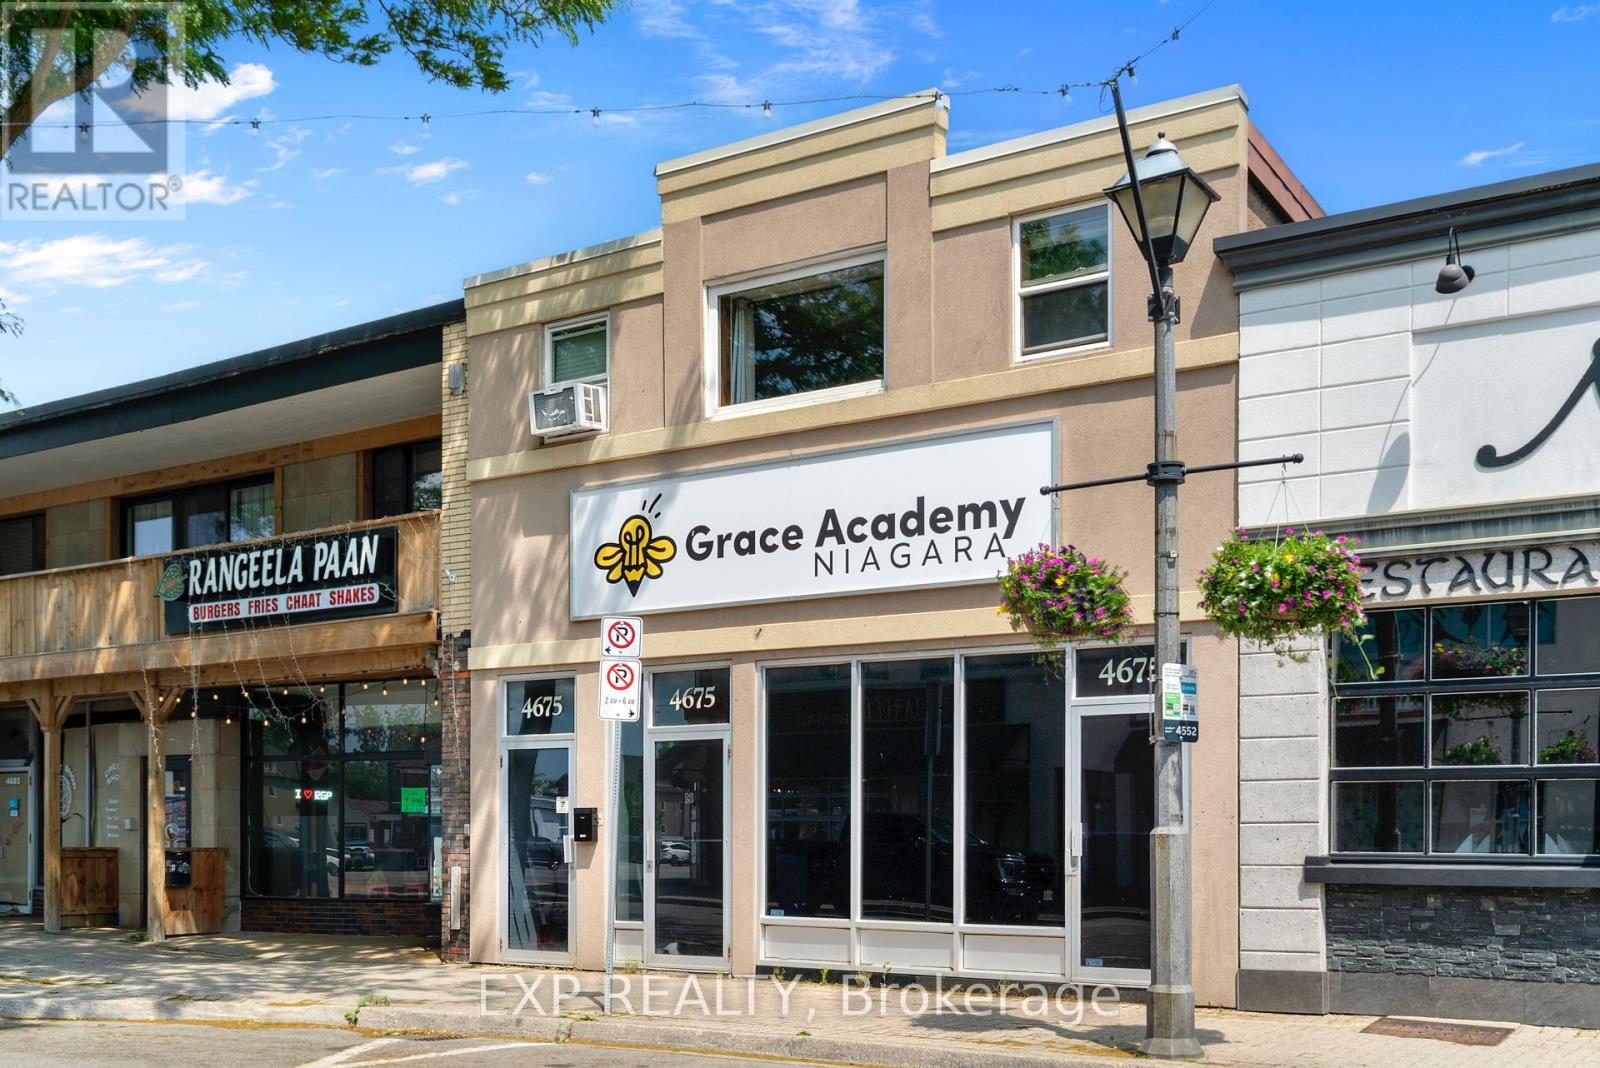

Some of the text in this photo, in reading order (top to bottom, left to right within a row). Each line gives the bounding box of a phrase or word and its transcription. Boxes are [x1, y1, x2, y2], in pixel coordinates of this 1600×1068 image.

[685, 495, 1026, 562] Grace Academy
[188, 534, 379, 597] RANGEELA PAAN
[814, 532, 1007, 578] NIAGARA
[1361, 546, 1600, 599] ESTAURA
[193, 585, 375, 621] BURGERS FRIES CHAAT SHAKES
[521, 695, 563, 719] 4675
[604, 696, 609, 705] 2
[622, 697, 627, 705] 6
[669, 685, 716, 711] 4675
[1176, 726, 1197, 736] 4552
[314, 790, 333, 800] RGP
